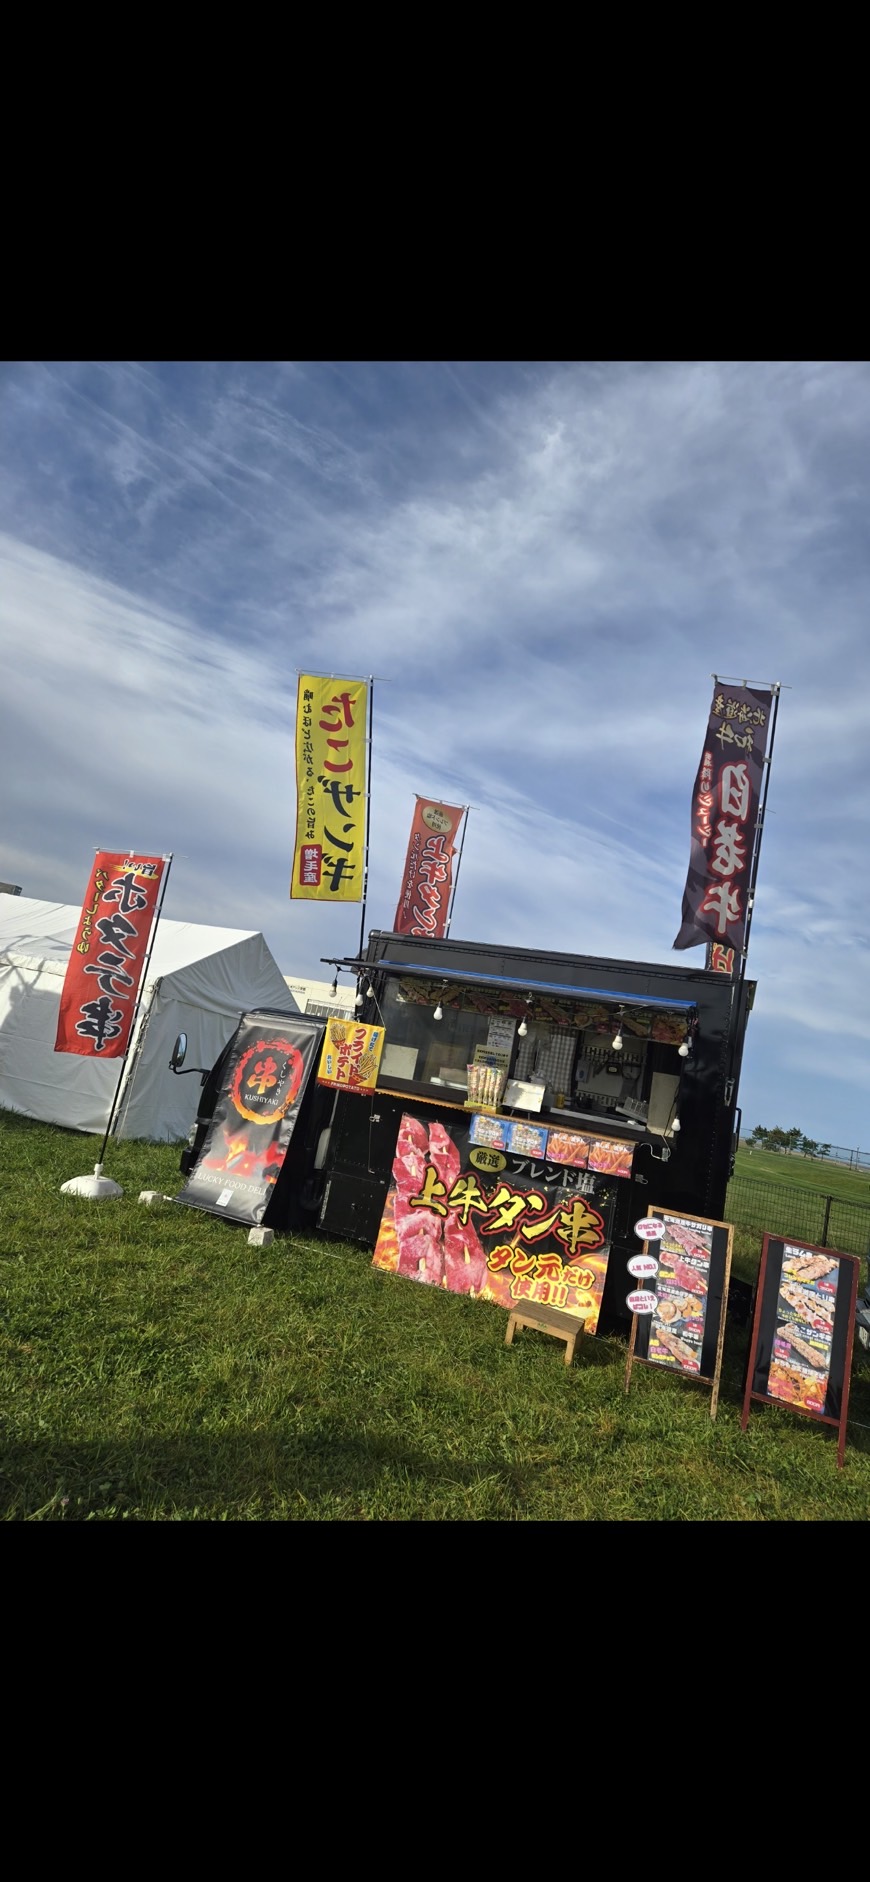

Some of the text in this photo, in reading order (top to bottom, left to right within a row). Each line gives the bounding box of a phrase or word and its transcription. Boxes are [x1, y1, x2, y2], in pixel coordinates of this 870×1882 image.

[335, 1043, 352, 1080] ポテト
[348, 1028, 367, 1076] フライド
[246, 1056, 278, 1094] 串
[275, 1062, 287, 1096] くしやき
[244, 1093, 279, 1106] KUSHIYAKI
[475, 1150, 500, 1167] 厳選
[512, 1158, 598, 1194] ブレンド塩
[197, 1171, 267, 1196] LUCKY FOOD DELI
[409, 1166, 603, 1253] 上牛タン串
[487, 1246, 595, 1288] タン元だけ
